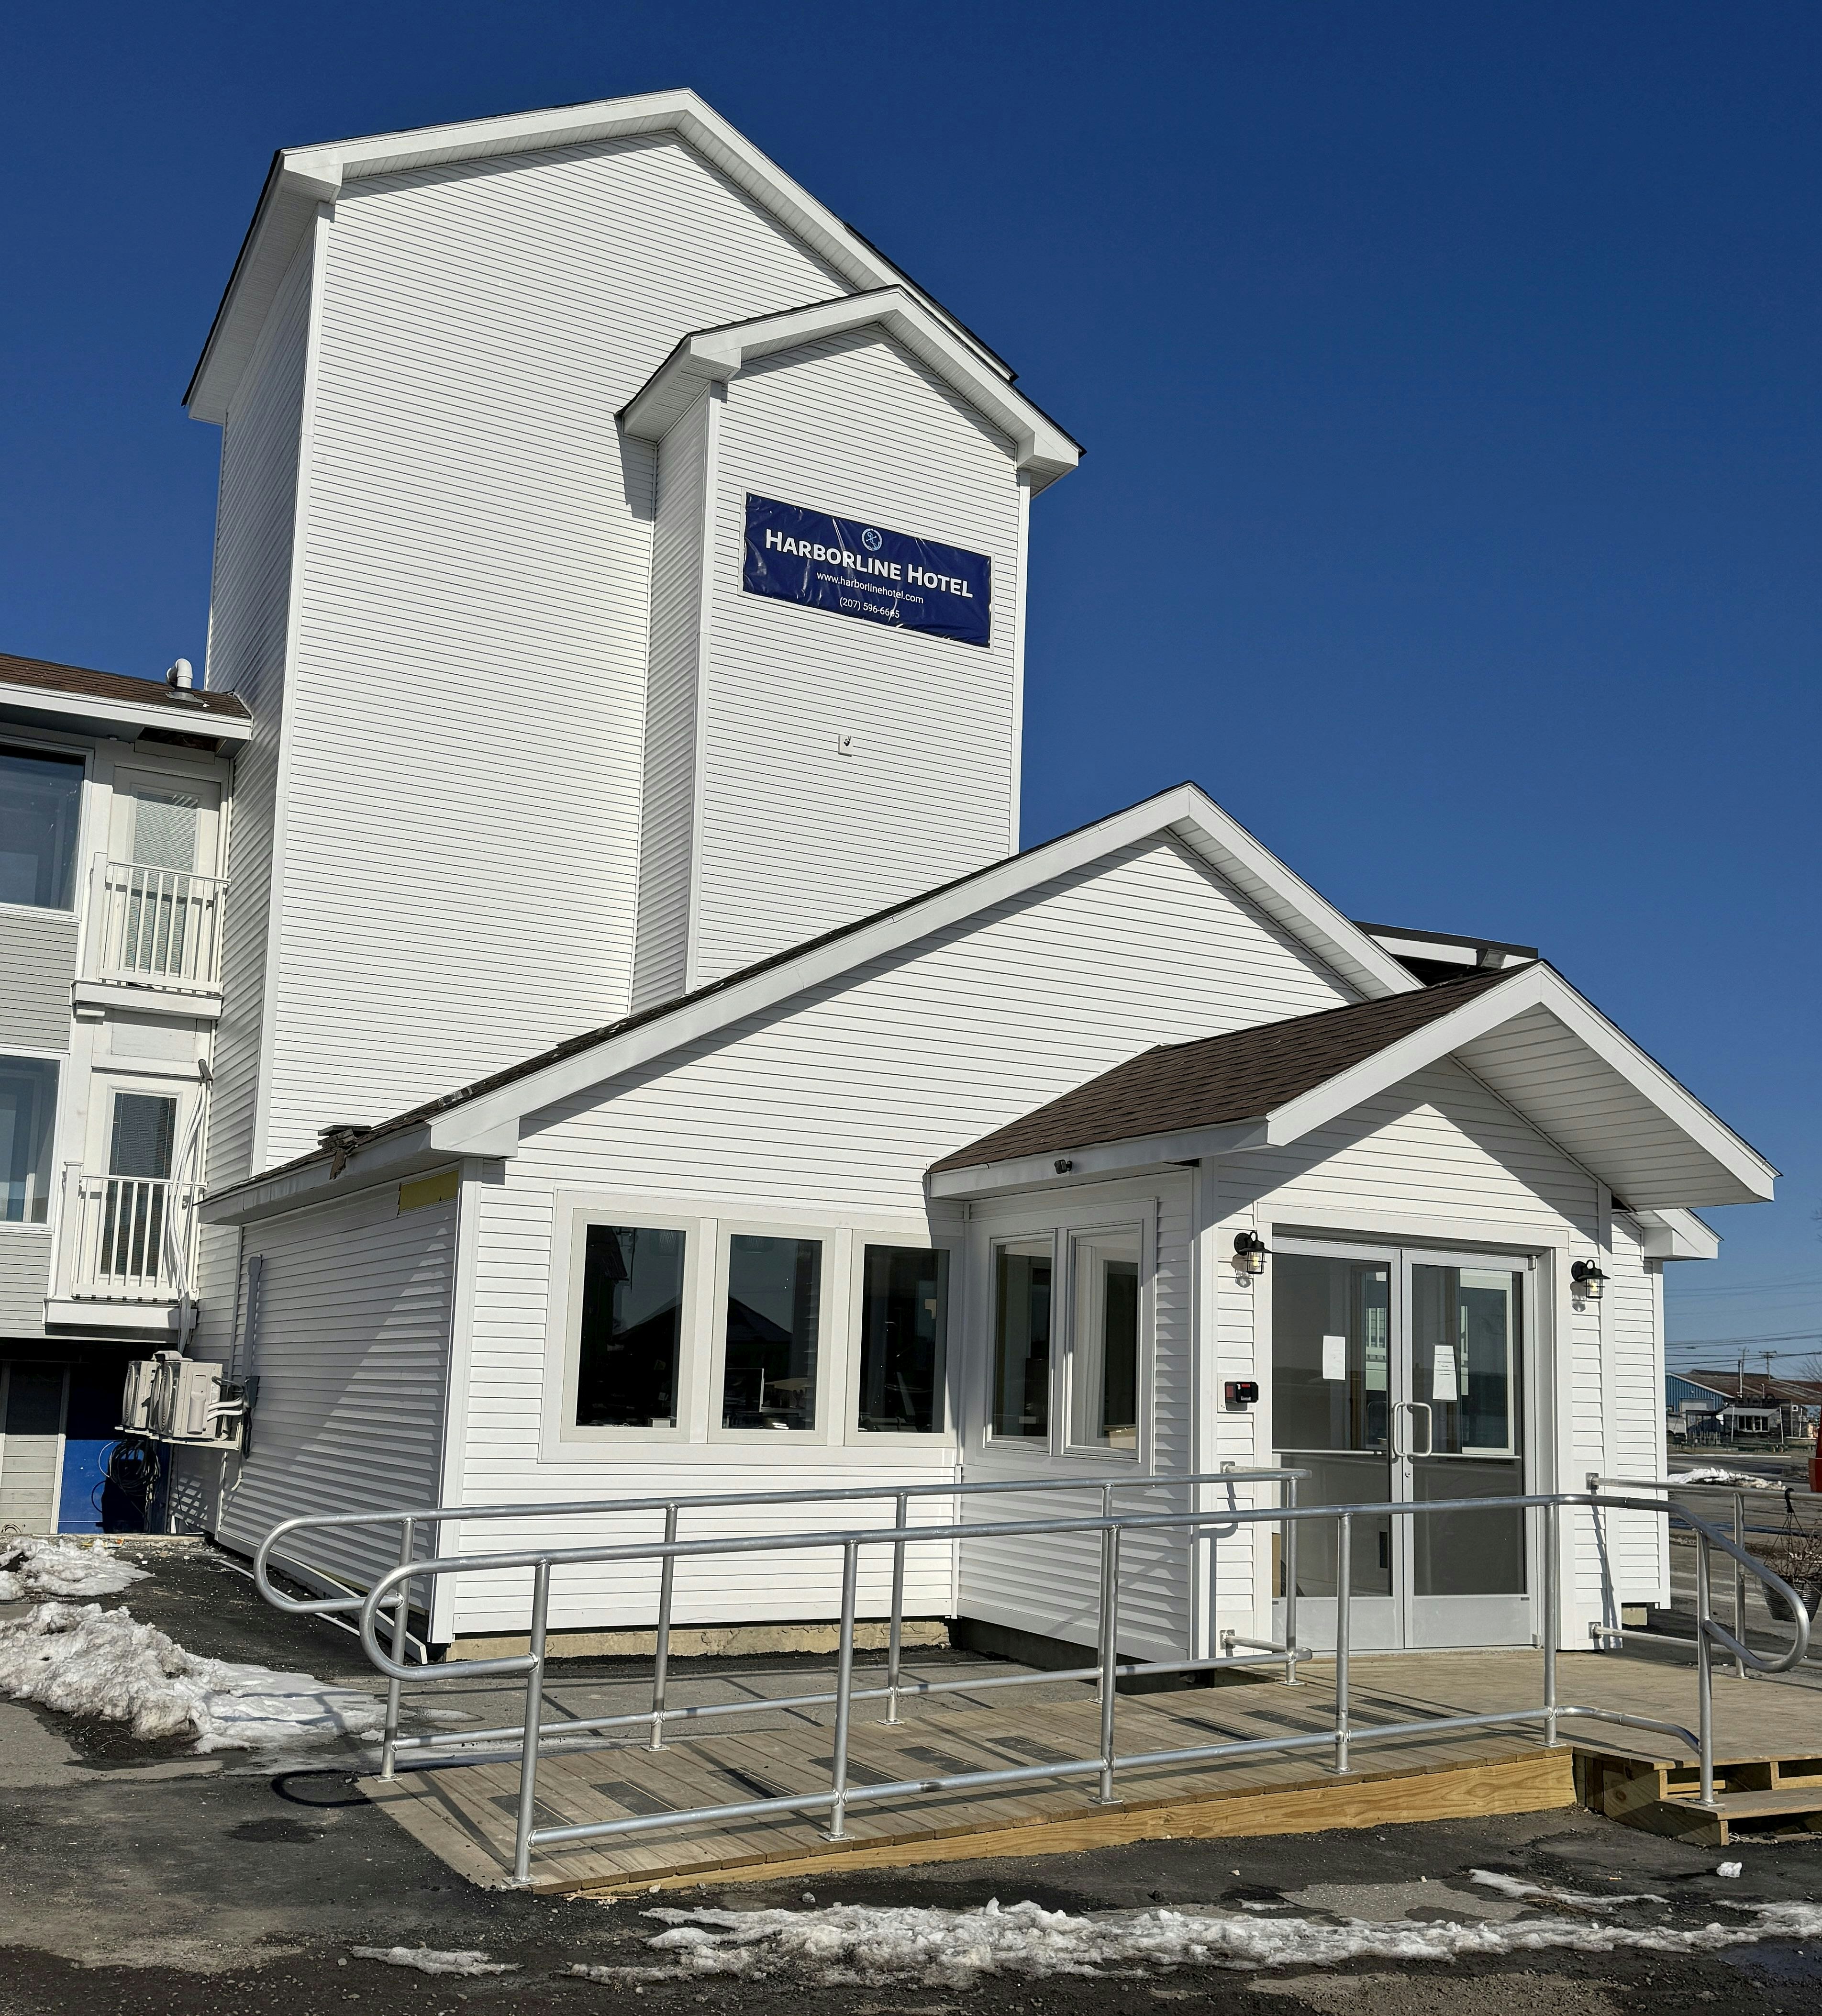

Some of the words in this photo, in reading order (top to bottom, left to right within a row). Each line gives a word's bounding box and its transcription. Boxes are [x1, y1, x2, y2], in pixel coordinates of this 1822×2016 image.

[766, 529, 901, 581] HARBORLINE
[908, 564, 973, 598] HOTEL
[816, 572, 924, 604] www.harborlinehotel.com
[839, 597, 861, 611] (207)
